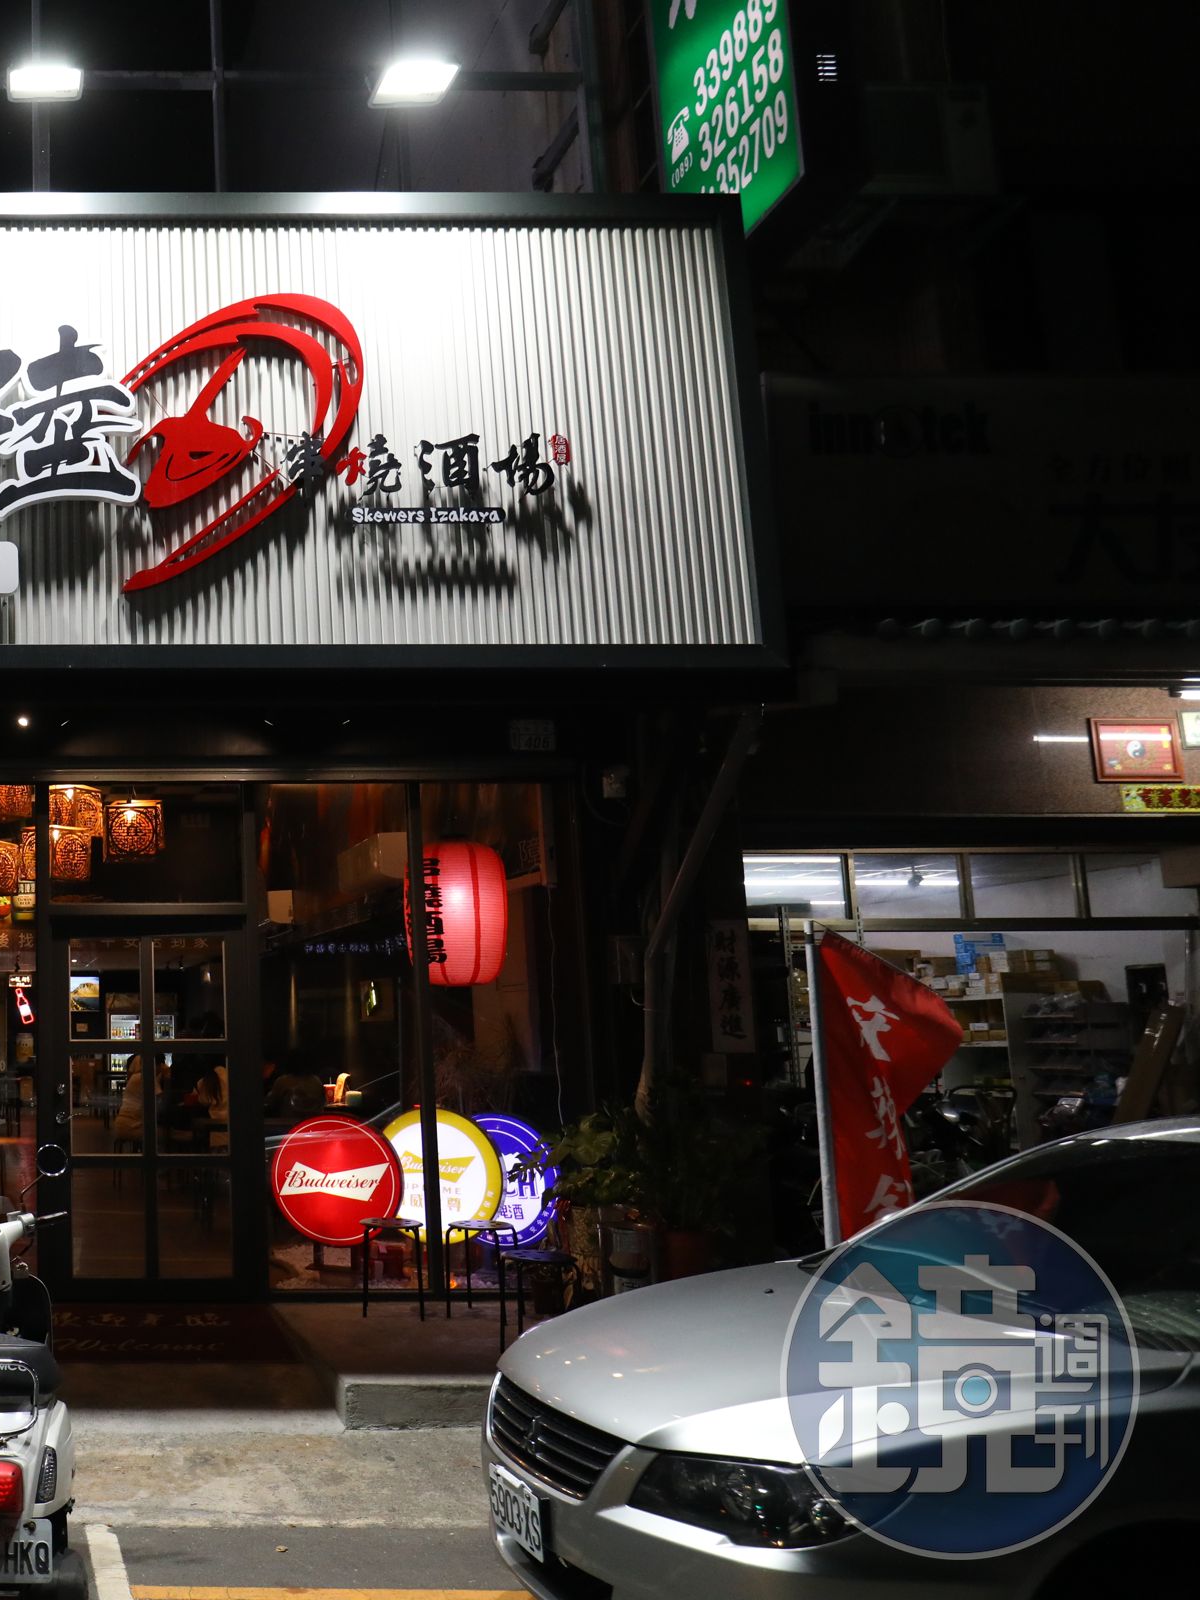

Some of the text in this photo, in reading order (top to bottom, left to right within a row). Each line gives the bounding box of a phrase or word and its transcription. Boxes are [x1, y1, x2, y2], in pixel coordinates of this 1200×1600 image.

[699, 28, 784, 172] 326158
[671, 152, 693, 188] (089)
[716, 90, 788, 194] 352709
[281, 431, 555, 499] 串燒酒場
[352, 507, 501, 523] Skewers Izakaya
[285, 1170, 380, 1189] Budweiser
[490, 1479, 541, 1552] 5903-XS
